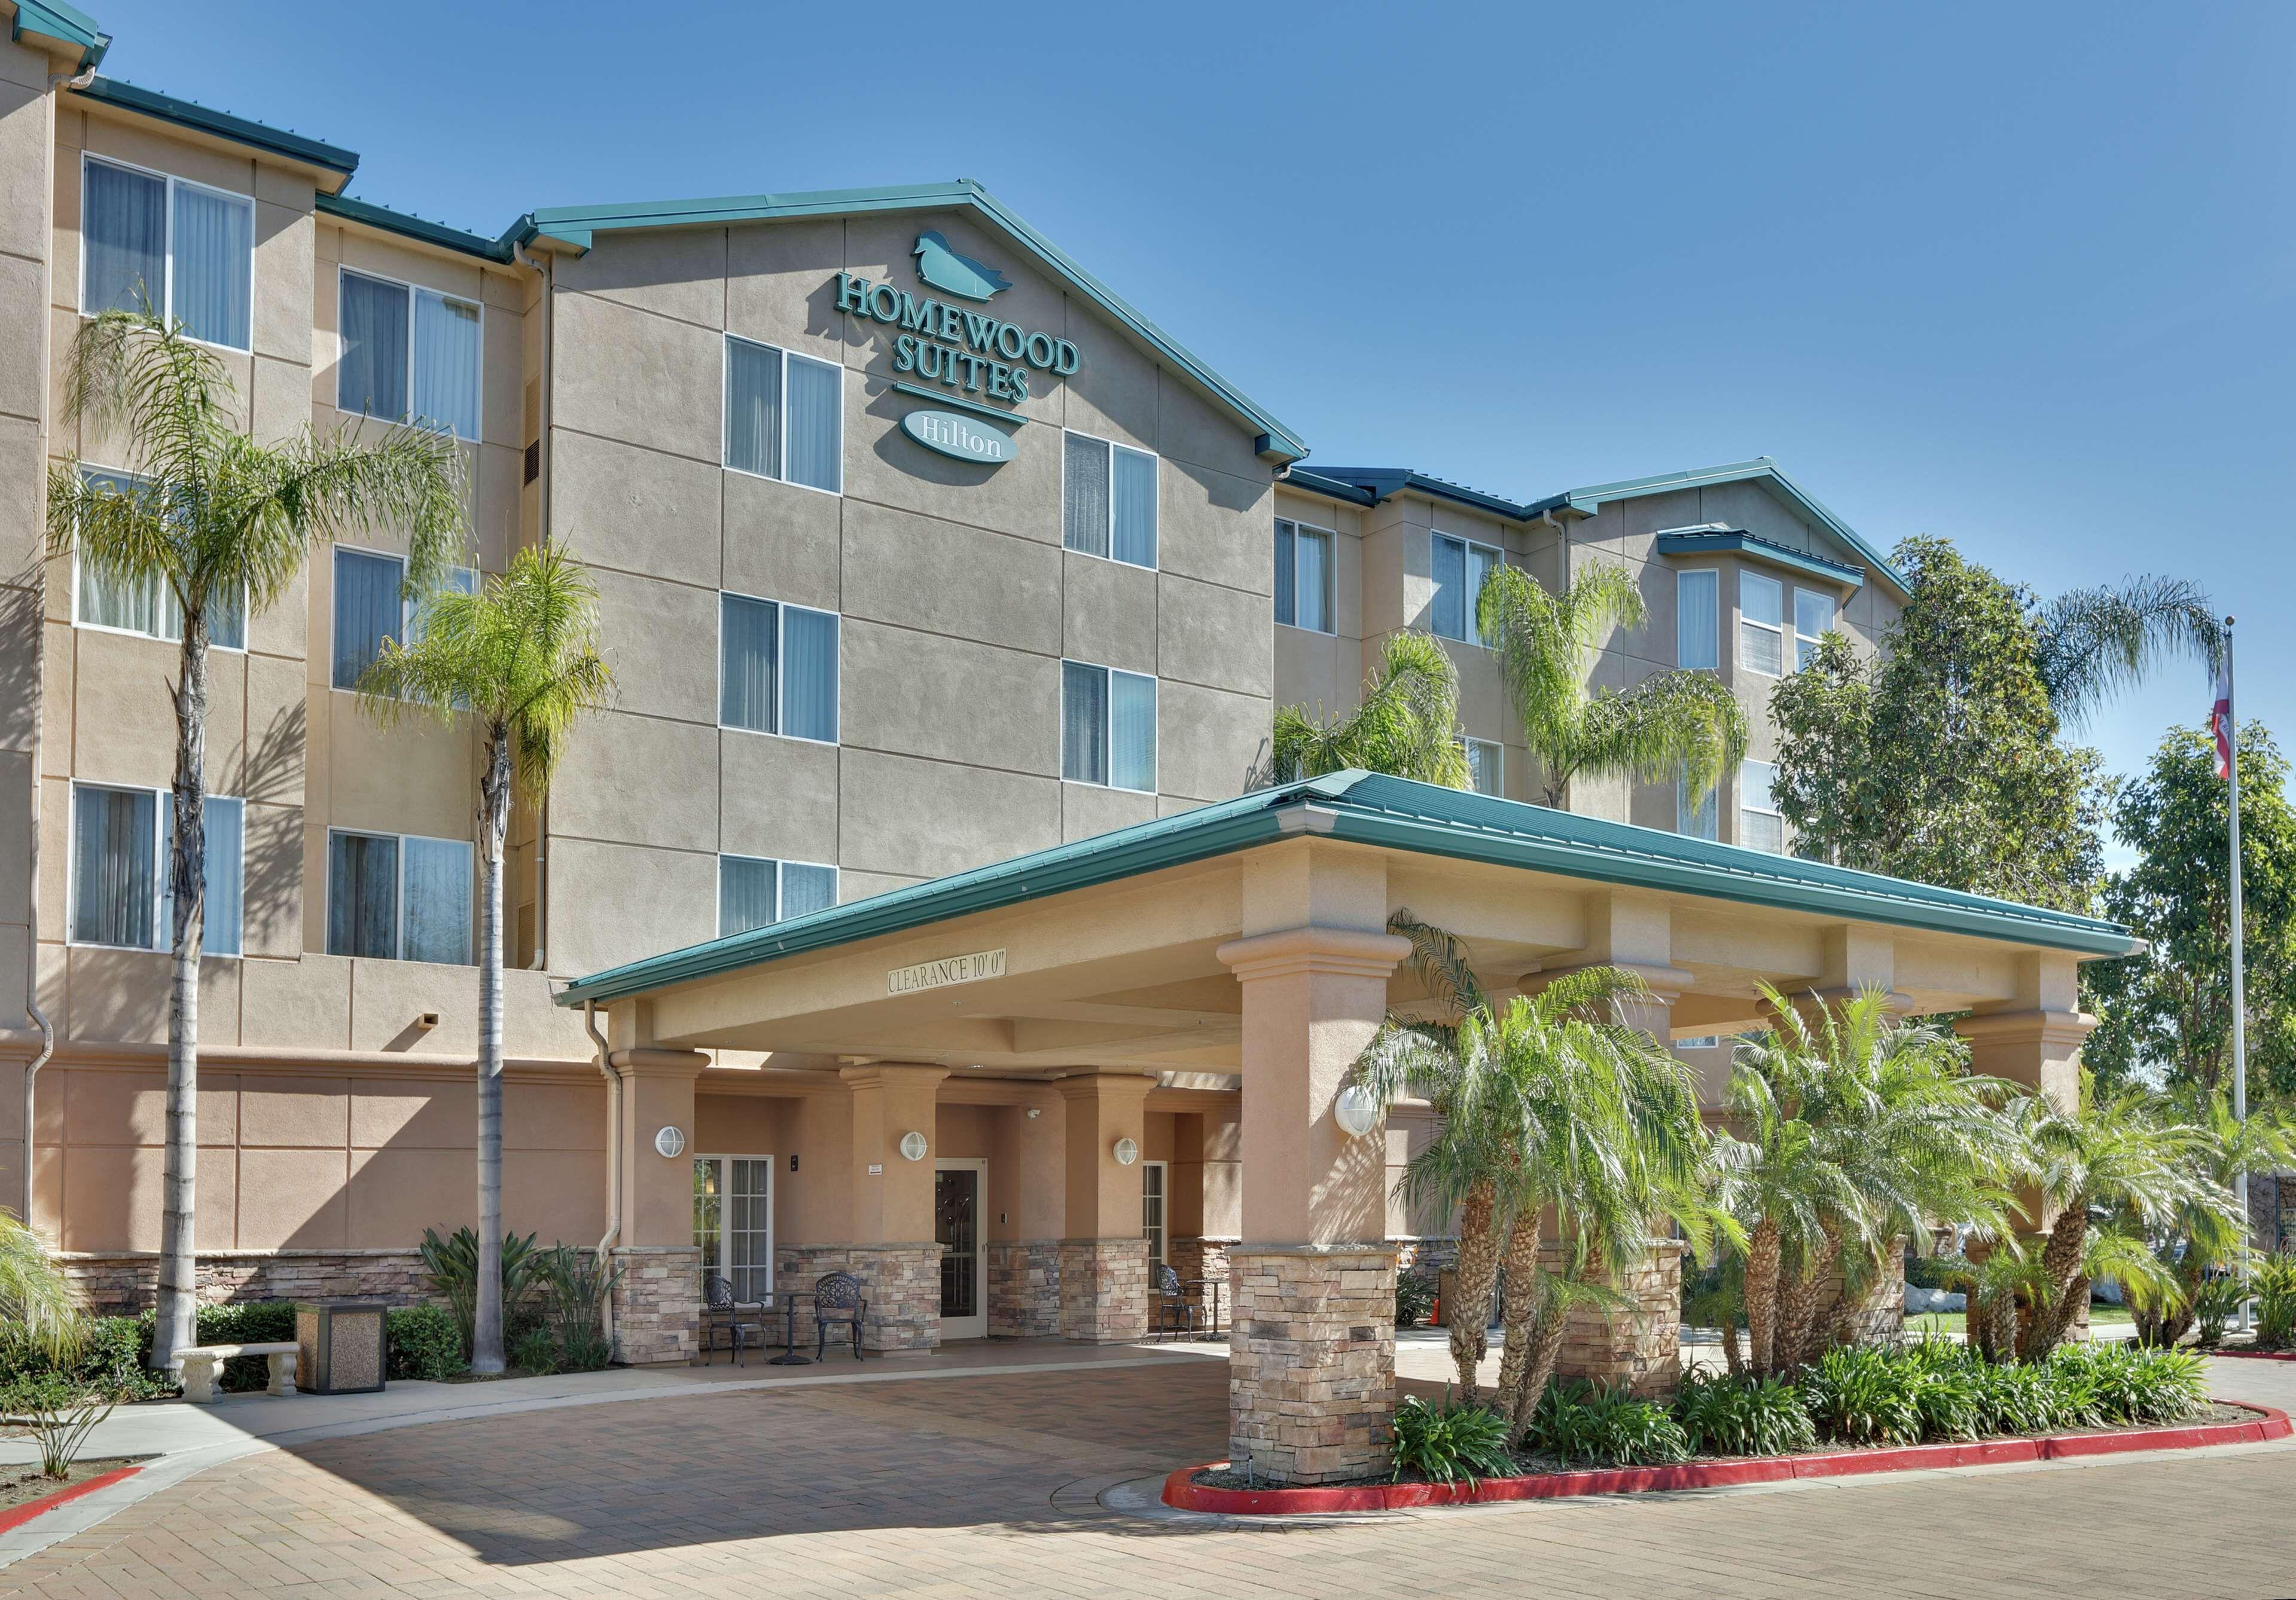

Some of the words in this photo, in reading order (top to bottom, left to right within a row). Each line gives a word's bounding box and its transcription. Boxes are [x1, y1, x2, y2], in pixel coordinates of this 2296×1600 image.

[835, 271, 1081, 377] HOMEWOOD
[892, 334, 1029, 404] SUITES
[921, 415, 1003, 459] Hilton
[888, 958, 968, 993] CLEARANCE
[974, 954, 987, 978] 10'
